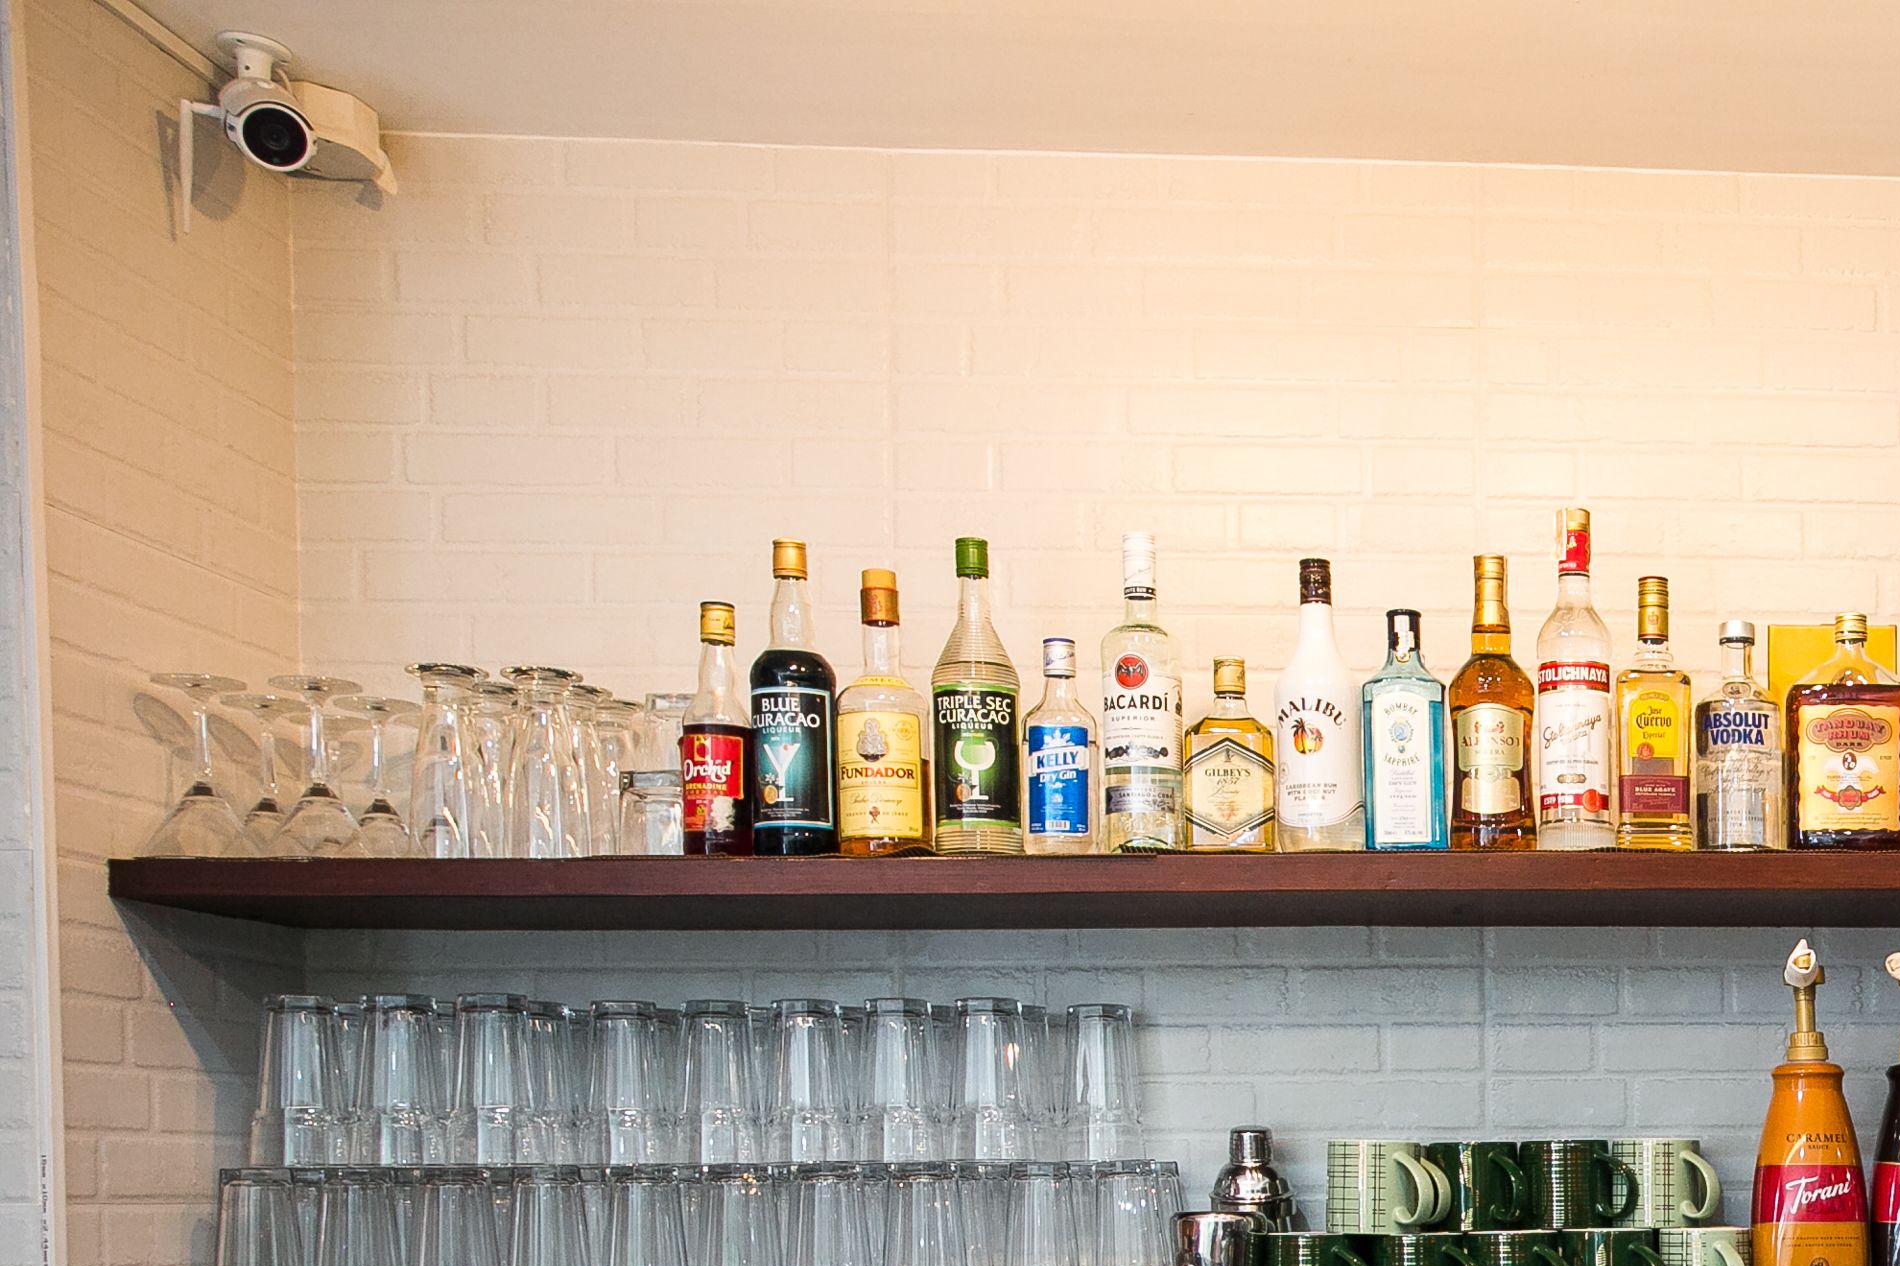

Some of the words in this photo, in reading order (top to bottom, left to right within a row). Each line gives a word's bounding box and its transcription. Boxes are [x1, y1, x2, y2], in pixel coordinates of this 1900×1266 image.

[1538, 665, 1608, 683] STOLICHNAYA
[762, 698, 799, 711] BLUE
[937, 695, 982, 710] TRIPLE
[986, 697, 1012, 712] SEC
[1104, 692, 1169, 712] BACARDÍ
[1384, 702, 1419, 716] BOMBAY
[938, 709, 1010, 725] CURACAO
[1278, 697, 1346, 728] MALIBU
[1636, 712, 1672, 729] Cuervo
[1704, 712, 1770, 729] ABSOLUT
[752, 713, 820, 729] CURACAO
[952, 722, 993, 730] LIQUEUR
[1813, 719, 1885, 733] TANDUAY
[1710, 728, 1765, 745] VODKA
[1828, 730, 1871, 741] RHUM
[1036, 751, 1079, 769] KELLY
[1384, 754, 1420, 766] SAPPHIRE
[684, 759, 732, 782] Orchid
[841, 766, 915, 780] FUNDADOR
[1040, 772, 1059, 783] Dry
[1059, 769, 1076, 780] Gin
[1205, 768, 1251, 777] GILBEY'S
[1786, 1176, 1852, 1214] Torani
